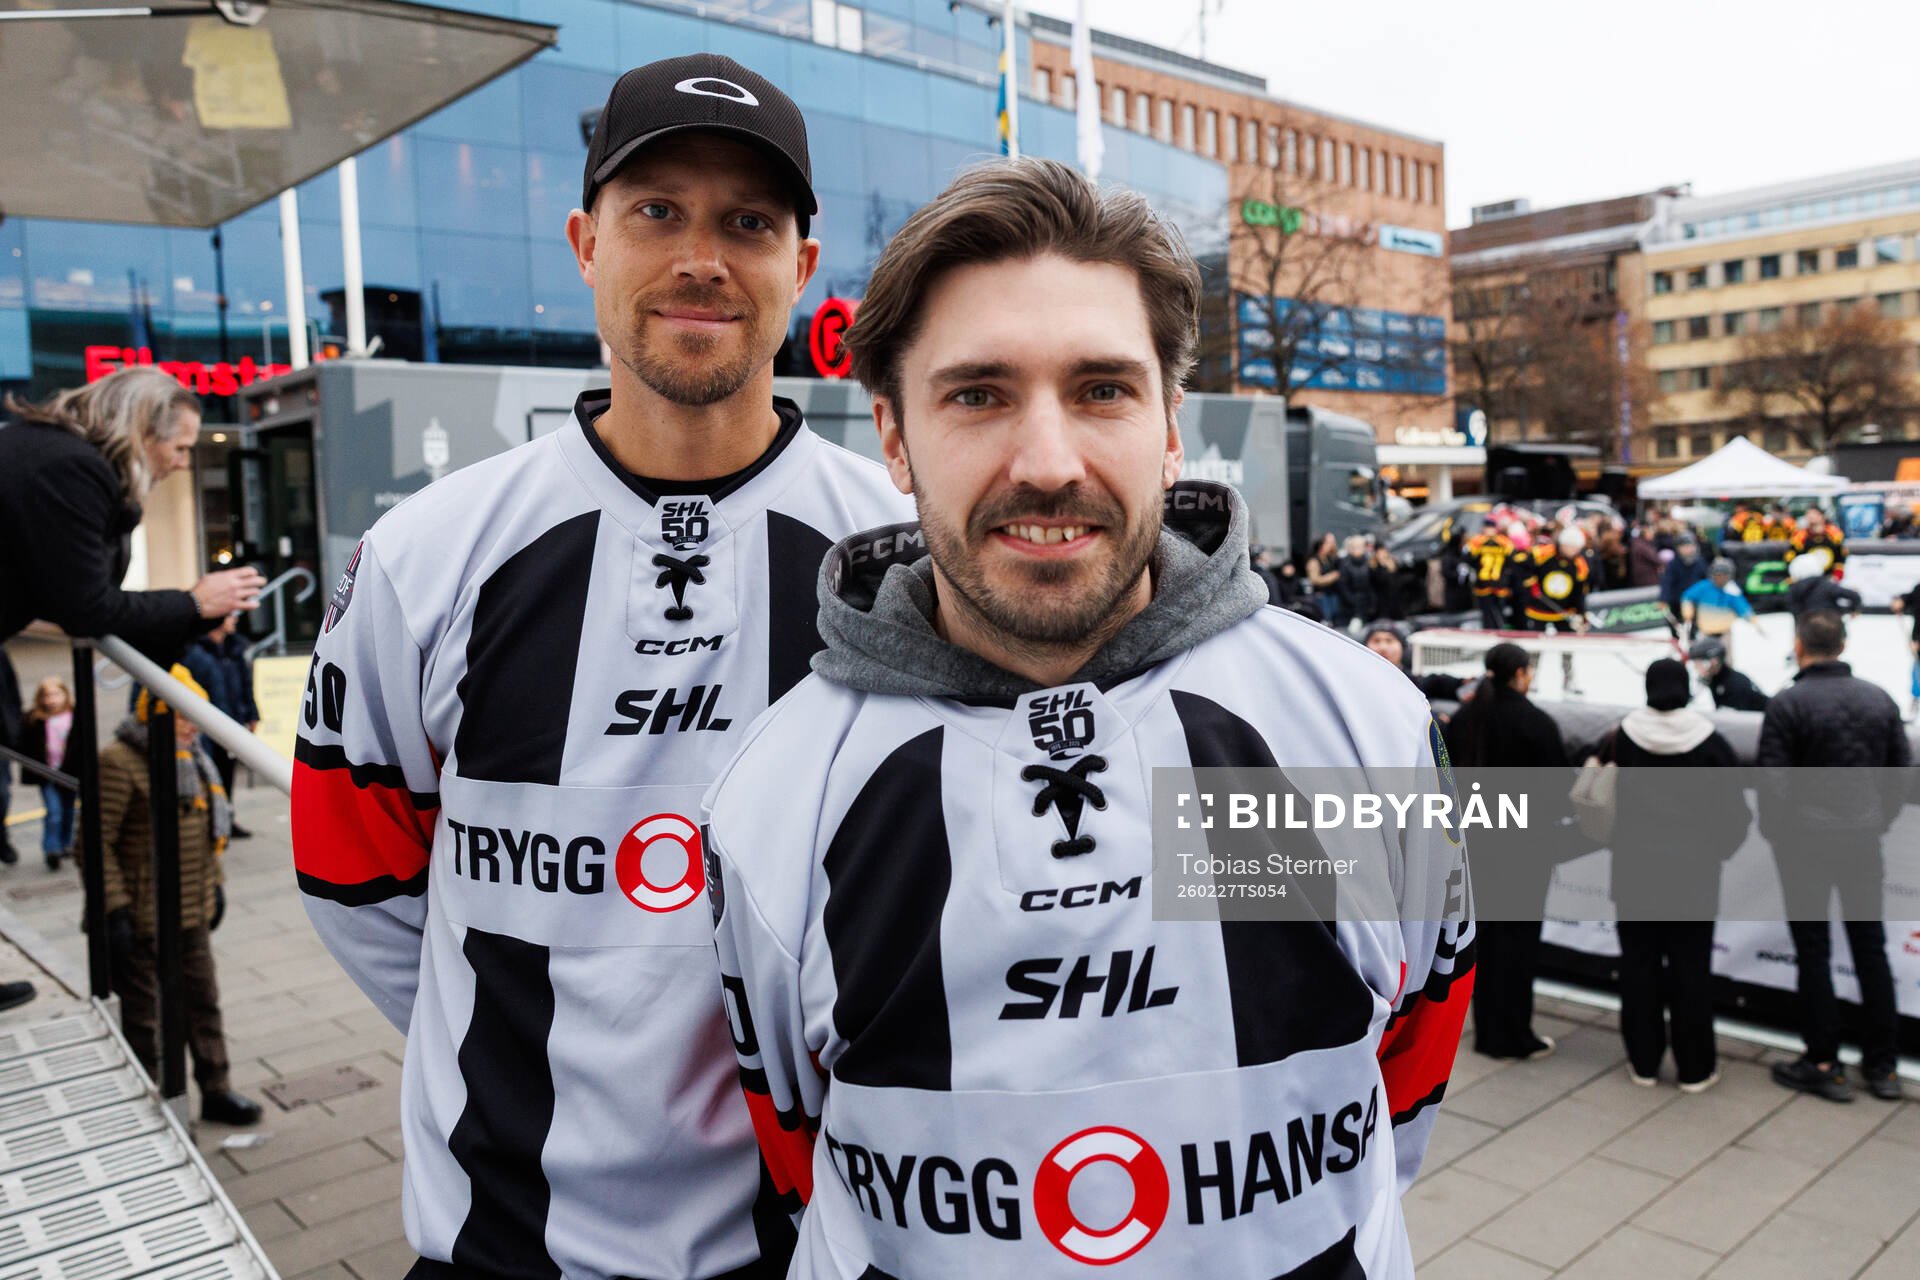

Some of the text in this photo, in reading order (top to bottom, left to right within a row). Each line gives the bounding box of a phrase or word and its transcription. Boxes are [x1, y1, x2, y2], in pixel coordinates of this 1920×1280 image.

[662, 501, 709, 517] SHL
[662, 517, 709, 543] 50
[635, 635, 724, 656] CCM
[305, 651, 347, 734] 50
[604, 684, 733, 735] SHL
[1028, 689, 1093, 718] SHL
[1029, 708, 1096, 751] 50
[448, 818, 606, 895] TRYGG
[1020, 876, 1142, 912] CCM
[999, 945, 1180, 1021] SHL
[825, 1084, 1378, 1241] TRYGG HANSA
